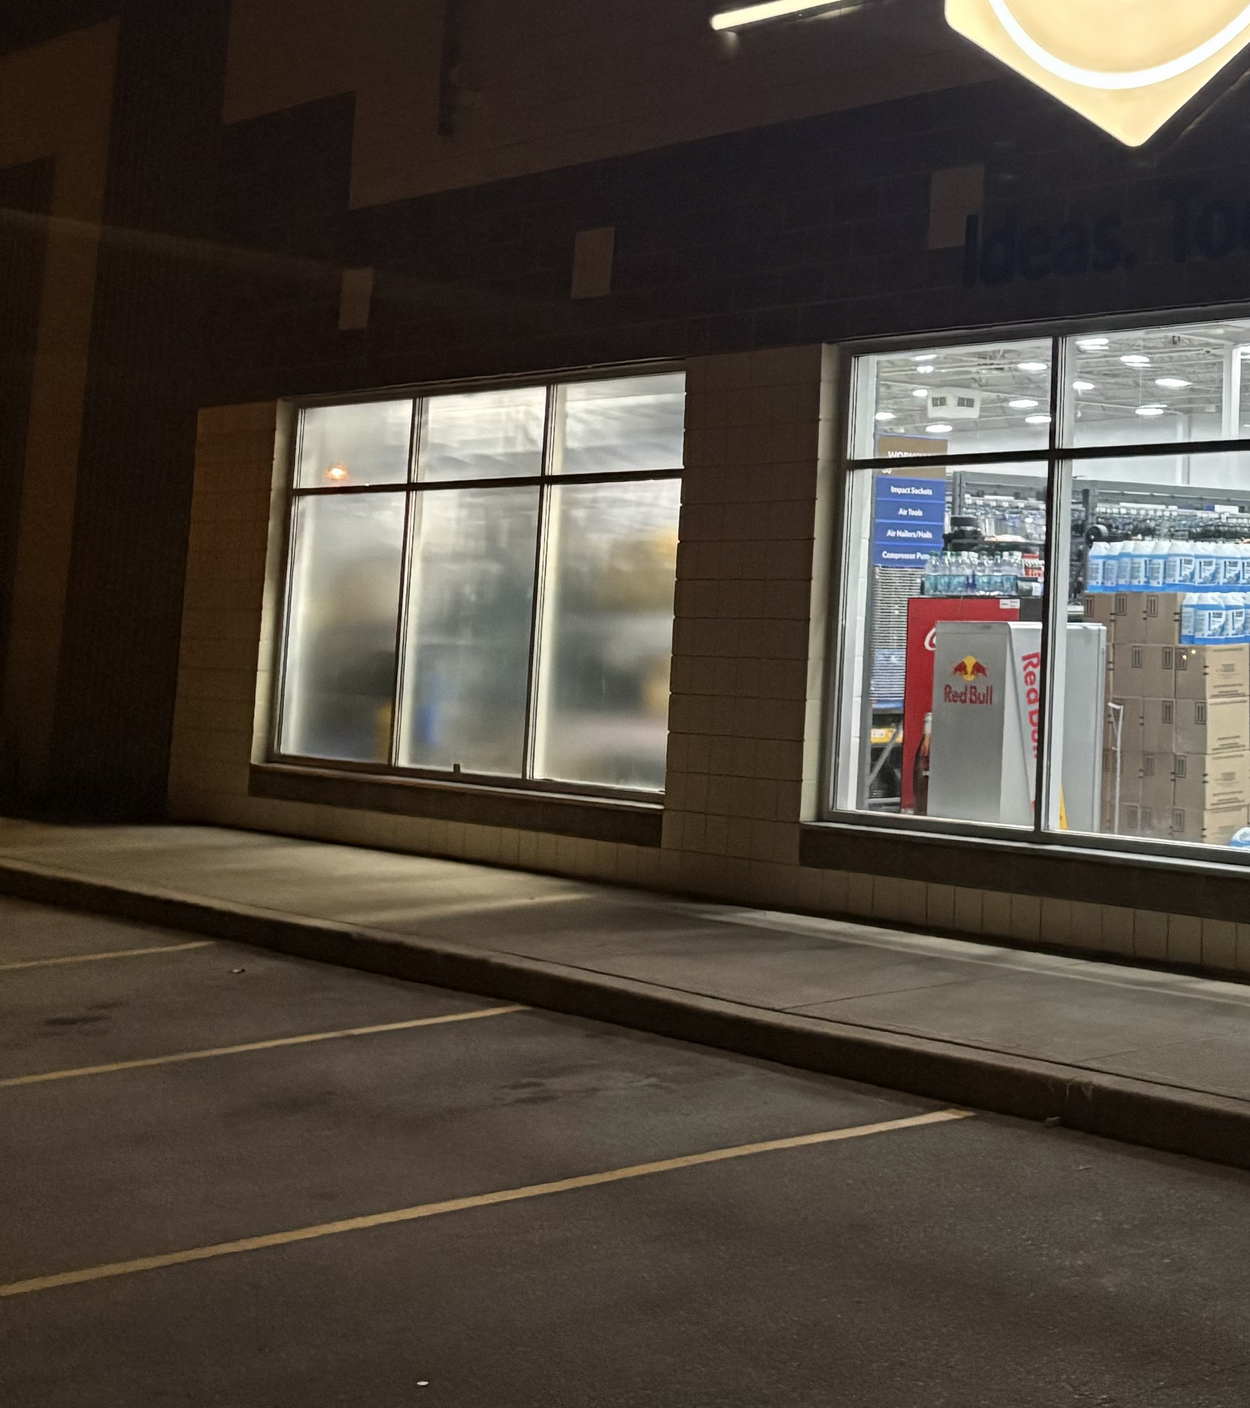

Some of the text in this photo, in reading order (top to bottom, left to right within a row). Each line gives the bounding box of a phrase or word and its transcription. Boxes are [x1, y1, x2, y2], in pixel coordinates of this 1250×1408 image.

[962, 206, 1139, 288] Ideas.
[890, 485, 910, 495] Impact
[898, 507, 923, 517] Air Tools
[886, 529, 896, 537] Air
[943, 684, 993, 705] Red Bull
